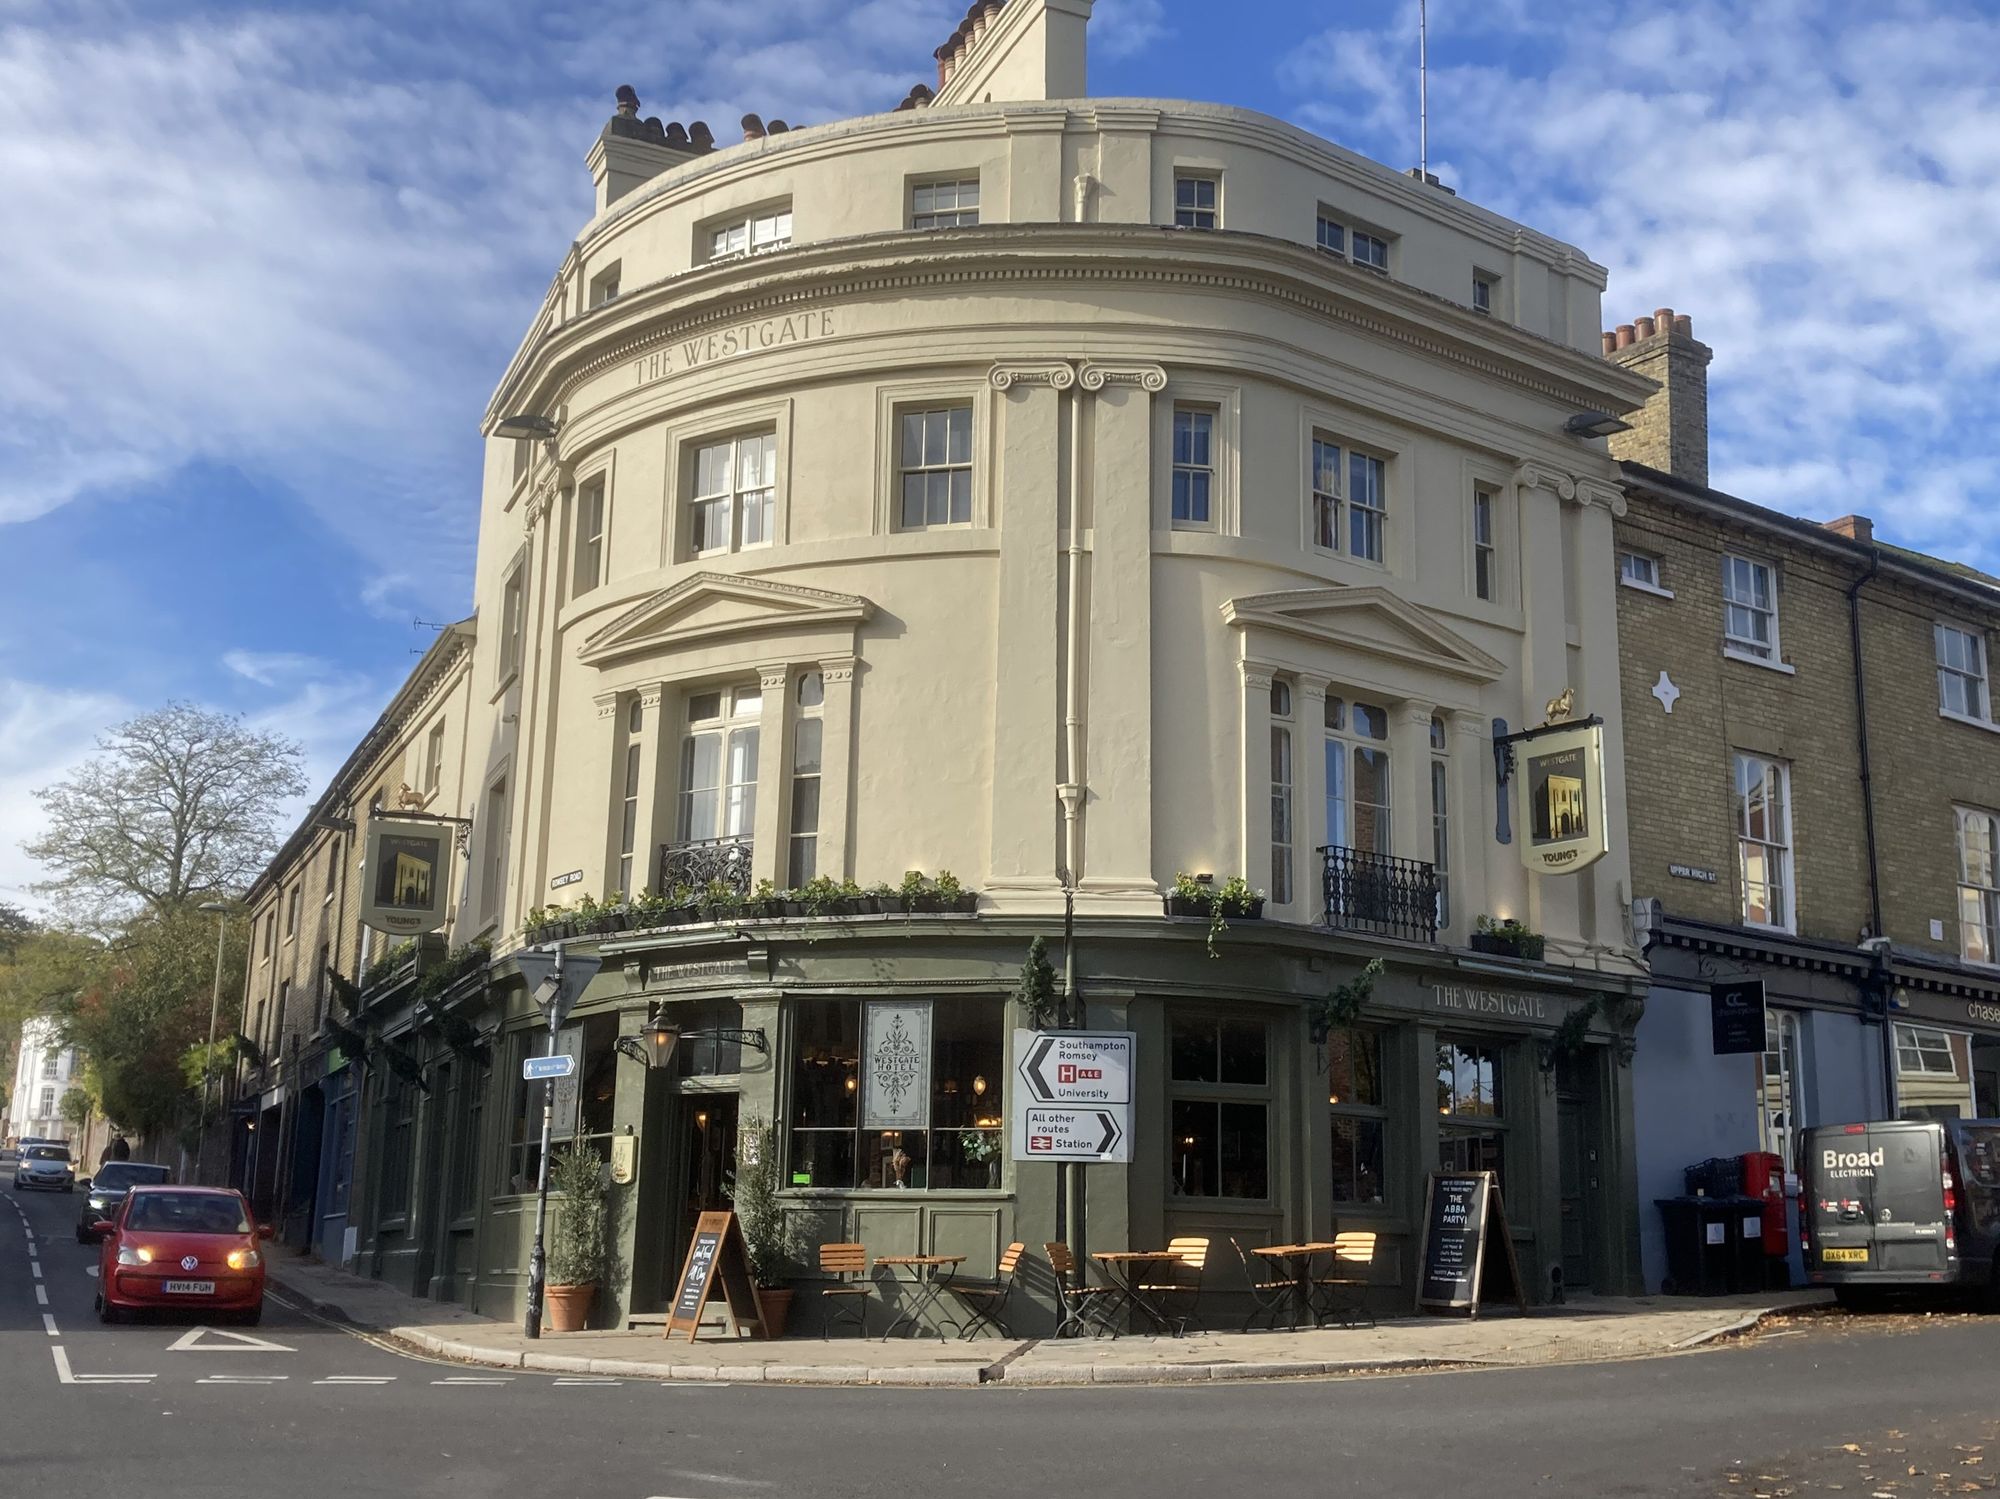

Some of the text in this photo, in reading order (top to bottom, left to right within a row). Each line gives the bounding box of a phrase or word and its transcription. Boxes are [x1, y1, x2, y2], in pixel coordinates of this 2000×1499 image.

[634, 308, 835, 384] THE WESTGATE
[1542, 849, 1578, 863] YOUNG'S
[1670, 864, 1690, 877] UPPER
[1691, 868, 1707, 881] HIGH
[653, 960, 736, 980] THE WESTGATE
[1432, 984, 1545, 1018] THE WESTGATE
[1059, 1040, 1126, 1051] Southampton
[874, 1056, 920, 1064] WESTGATE
[1059, 1051, 1098, 1062] Romsey
[878, 1063, 914, 1071] HOTEL
[1061, 1066, 1100, 1082] H A&E
[1058, 1088, 1109, 1099] University
[1032, 1113, 1075, 1122] All other
[1037, 1125, 1070, 1133] routes
[1056, 1138, 1092, 1148] Station
[1823, 1147, 1884, 1169] Broad
[1830, 1168, 1874, 1178] ELECTRICAL
[1449, 1194, 1462, 1204] THE
[1444, 1204, 1466, 1214] ABBA
[1847, 1250, 1864, 1259] XRC
